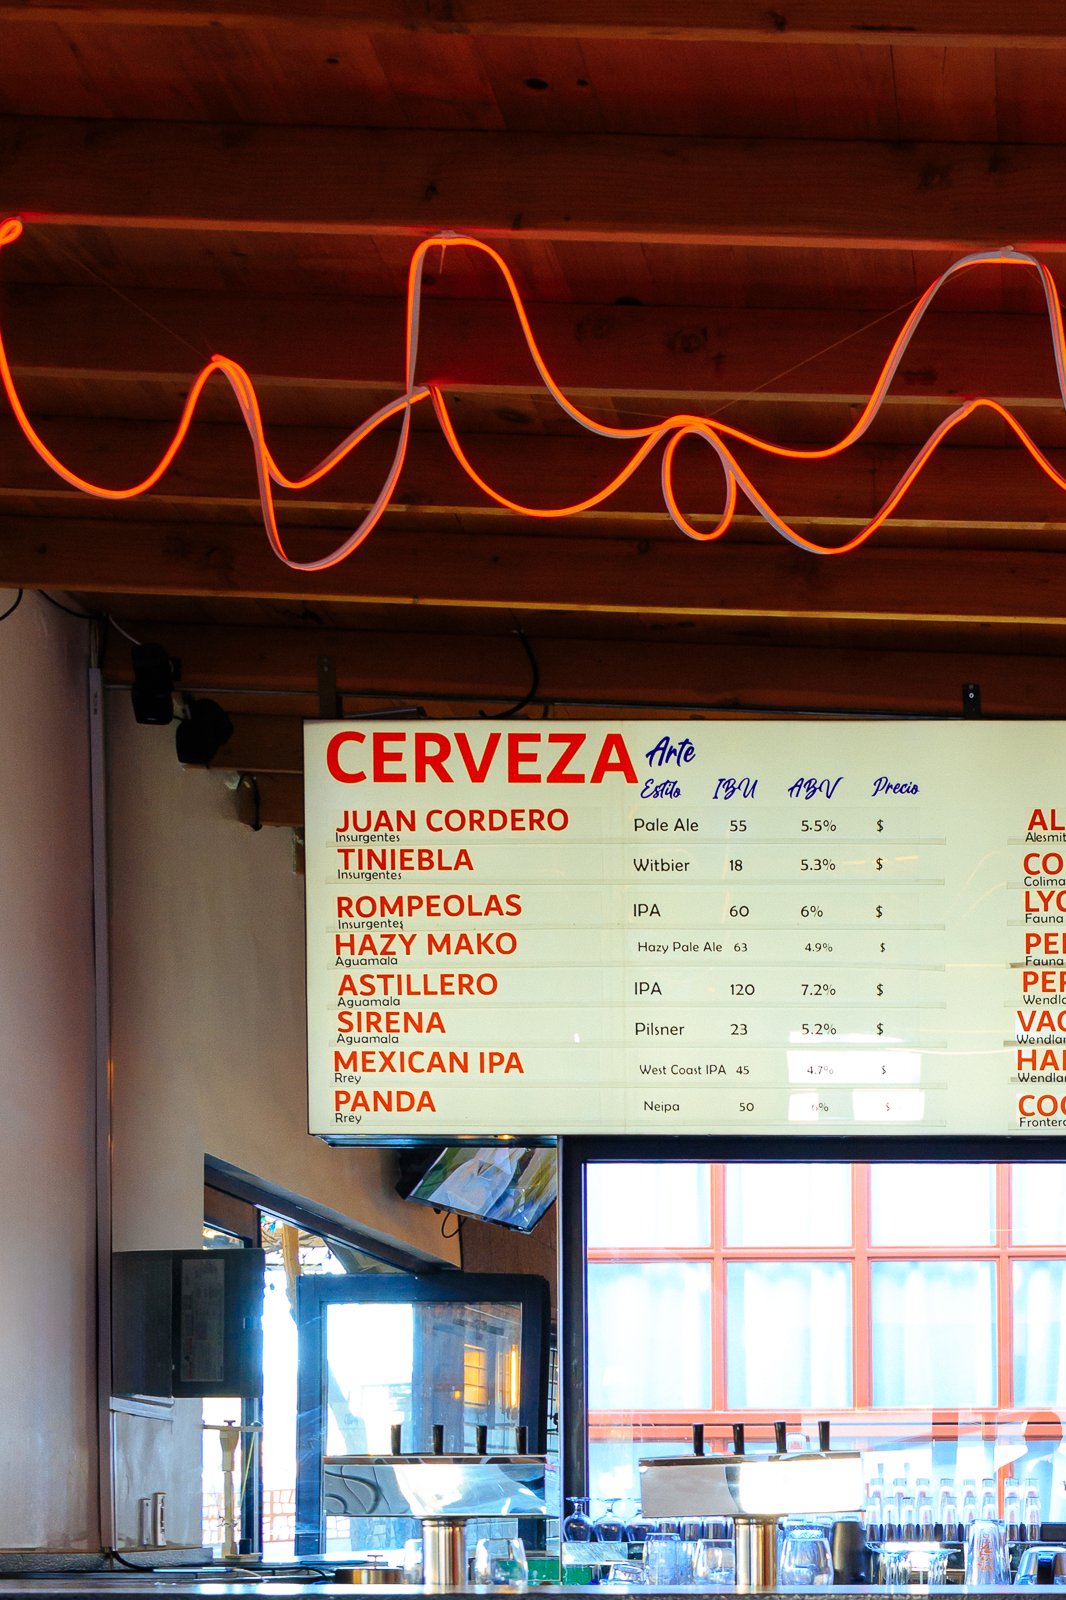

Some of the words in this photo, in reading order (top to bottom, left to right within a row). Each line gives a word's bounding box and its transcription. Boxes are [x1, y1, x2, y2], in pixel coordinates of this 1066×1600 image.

[327, 731, 638, 784] CERVEZA
[645, 735, 697, 768] Arte
[640, 778, 682, 799] Estilo
[712, 777, 760, 800] IBU
[787, 776, 844, 800] ABV
[872, 777, 921, 798] Precio
[337, 810, 416, 832] JUAN
[426, 808, 568, 832] CORDERO
[633, 817, 669, 832] Pale
[673, 817, 699, 832] Ale
[729, 819, 747, 832] 55
[801, 819, 837, 832] 5.5%
[876, 818, 884, 833] $
[336, 832, 401, 845] Insurgentes
[338, 848, 473, 870] TINIEBLA
[633, 858, 691, 872] Witbier
[729, 859, 743, 872] 18
[800, 858, 836, 871] 5.3%
[876, 857, 883, 872] $
[337, 868, 402, 882] Insurgentes
[1023, 875, 1066, 887] Colima
[337, 894, 521, 918] ROMPEOLAS
[633, 903, 661, 917] IPA
[729, 905, 750, 918] 60
[800, 905, 824, 918] 6%
[875, 904, 883, 919] $
[337, 918, 404, 931] Insurgentes
[1025, 912, 1064, 924] Fauna
[336, 934, 416, 955] HAZY
[428, 933, 517, 955] MAKO
[637, 941, 669, 954] Hazy
[672, 941, 700, 953] Pale
[703, 941, 723, 952] Ale
[733, 942, 748, 952] 63
[804, 942, 833, 952] 4.9%
[336, 956, 398, 968] Aguamala
[1025, 955, 1064, 967] Fauna
[338, 973, 497, 996] ASTILLERO
[634, 981, 662, 996] IPA
[730, 983, 755, 996] 120
[801, 983, 836, 996] 7.2%
[876, 983, 884, 997] $
[337, 996, 401, 1009] Aguamala
[338, 1011, 445, 1033] SIRENA
[635, 1022, 685, 1036] Pilsner
[730, 1023, 748, 1036] 23
[802, 1023, 837, 1035] 5.2%
[876, 1022, 884, 1036] $
[336, 1033, 399, 1046] Aguamala
[334, 1051, 468, 1073] MEXICAN
[480, 1052, 523, 1073] IPA
[639, 1064, 667, 1075] West
[670, 1064, 702, 1075] Coast
[706, 1064, 727, 1075] IPA
[735, 1065, 750, 1075] 45
[334, 1072, 362, 1085] Rrey
[335, 1090, 435, 1112] PANDA
[643, 1100, 680, 1113] Neipa
[739, 1102, 755, 1112] 50
[334, 1112, 362, 1125] Rrey
